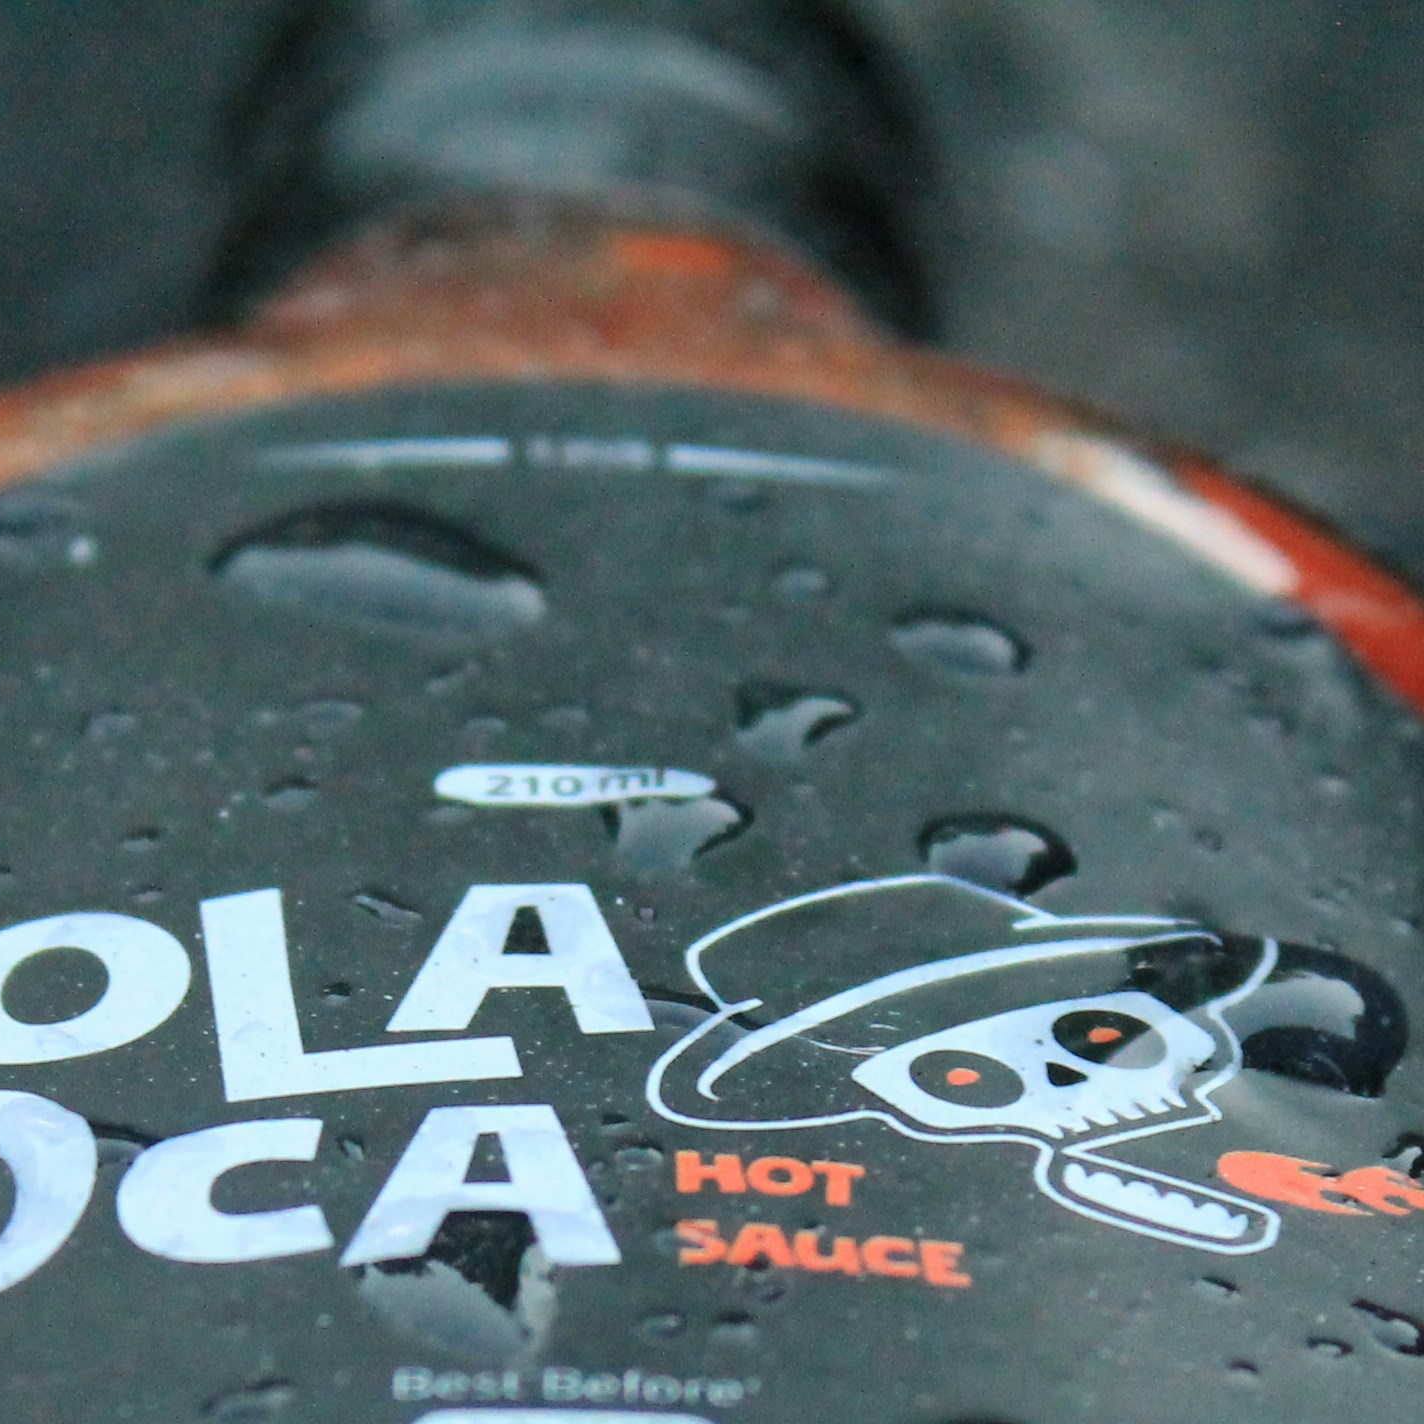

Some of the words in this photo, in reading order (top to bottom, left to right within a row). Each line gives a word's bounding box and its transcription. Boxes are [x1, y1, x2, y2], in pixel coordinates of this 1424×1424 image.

[485, 774, 583, 797] 210
[600, 766, 666, 793] ml
[675, 1150, 866, 1207] HOT
[675, 1218, 973, 1288] SAUCE
[392, 1366, 520, 1401] Best
